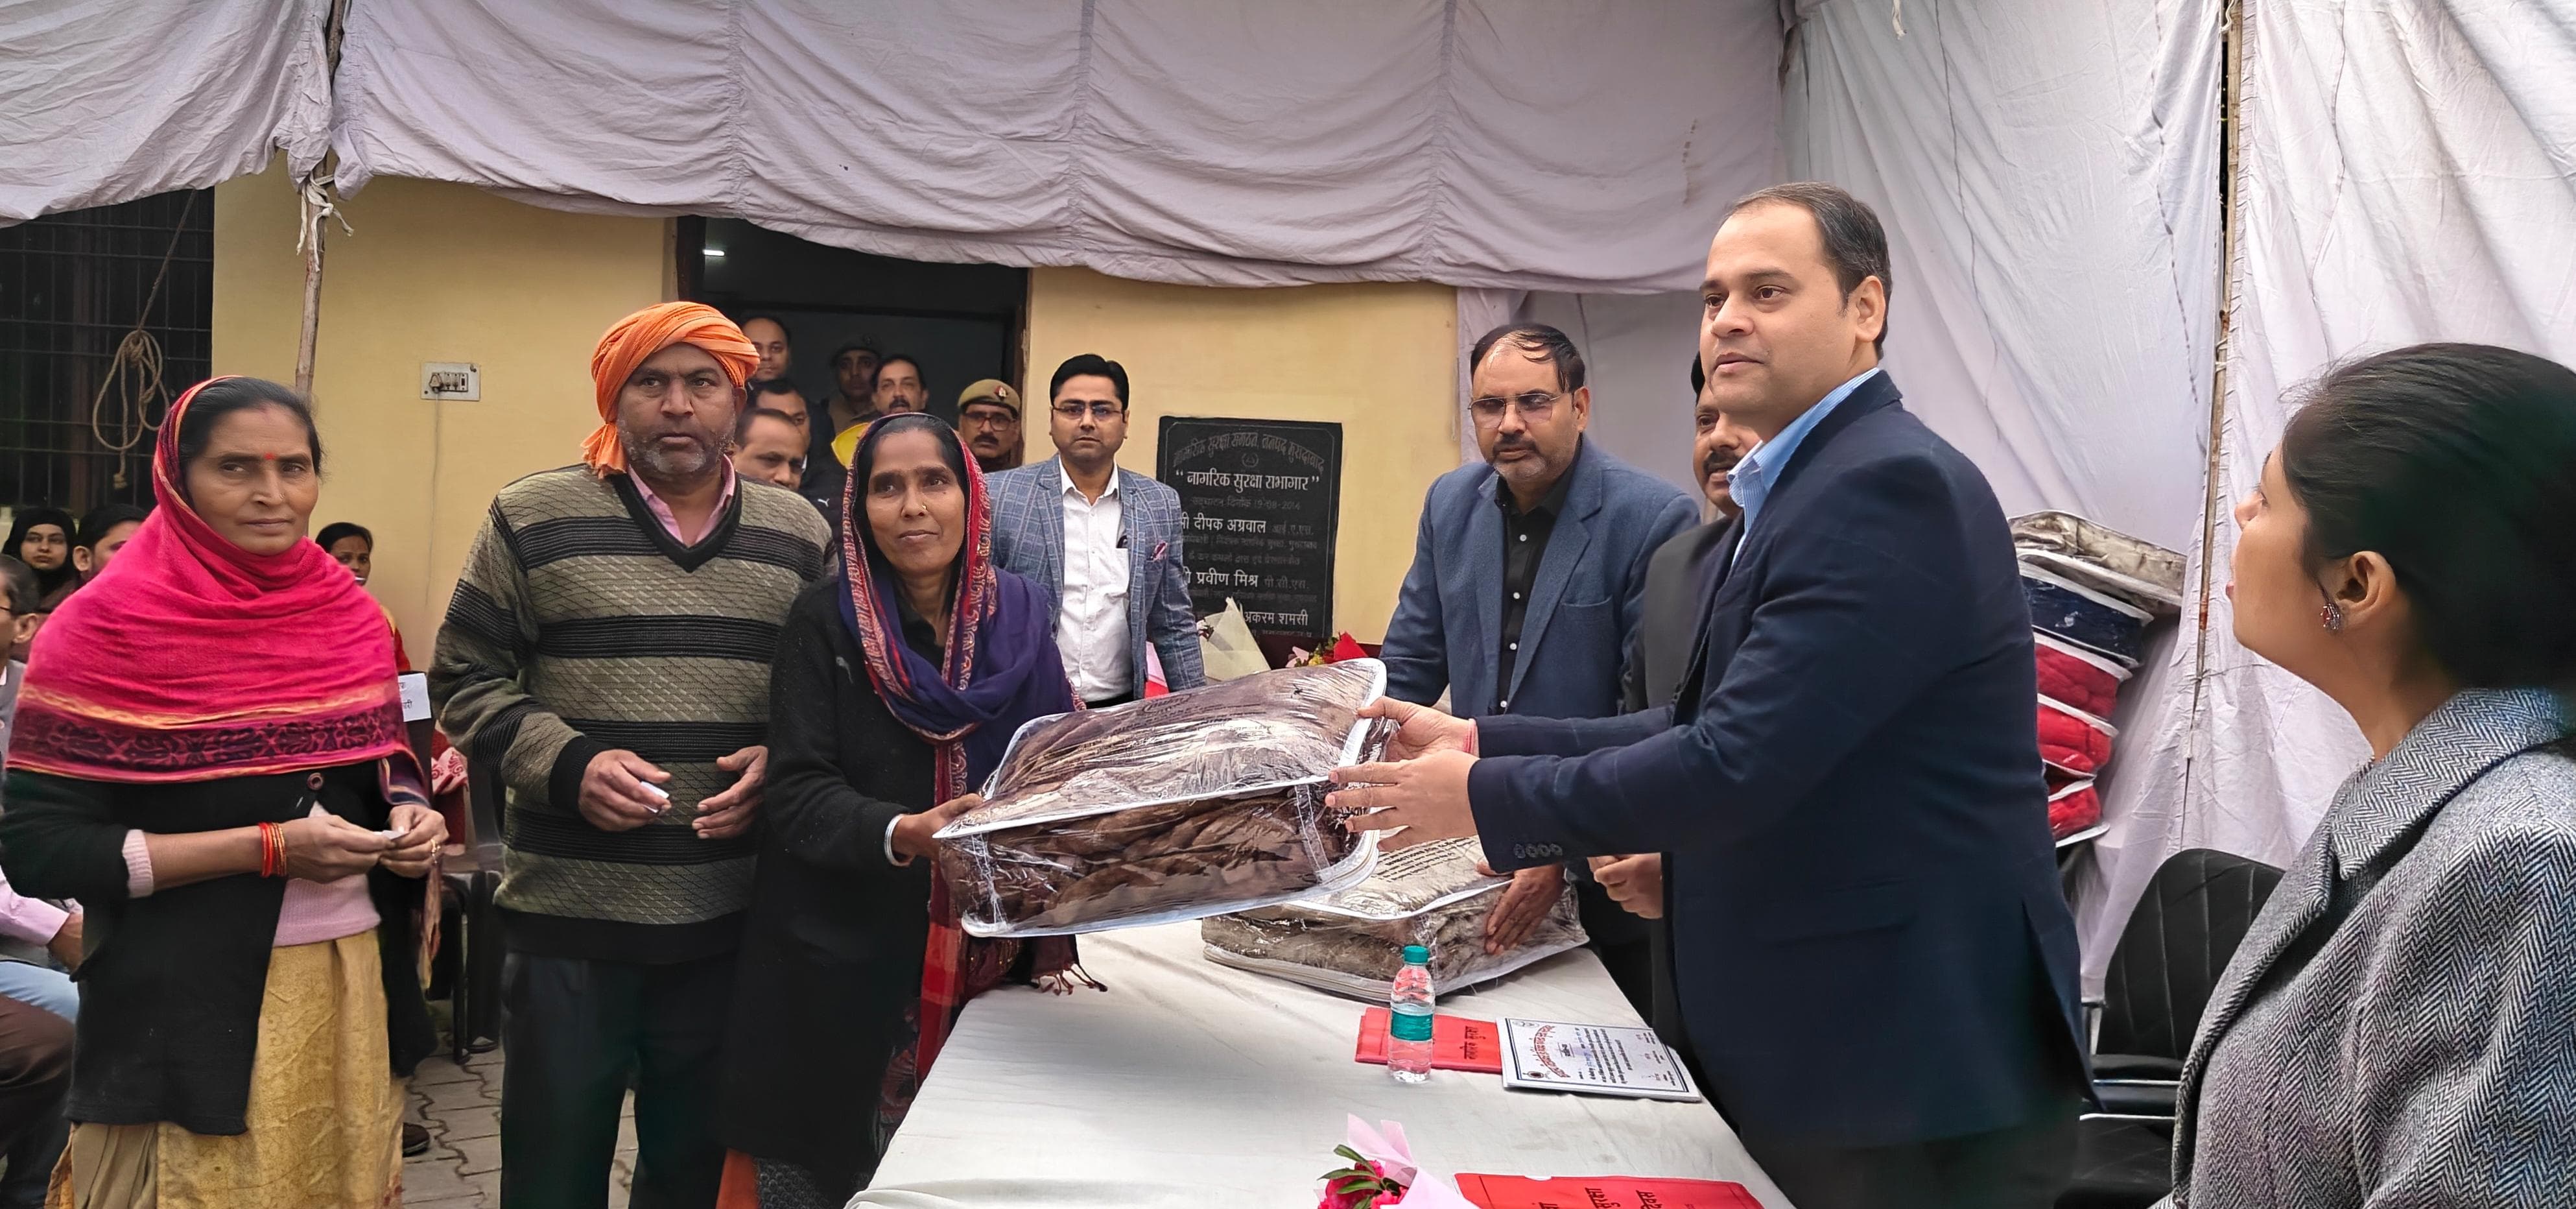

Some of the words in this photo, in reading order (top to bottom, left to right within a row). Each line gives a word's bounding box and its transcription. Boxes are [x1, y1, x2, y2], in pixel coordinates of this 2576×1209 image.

[1233, 473, 1262, 494] सुरक्षा
[1193, 512, 1224, 531] दीपक
[1227, 519, 1266, 534] अग्रवाल
[1196, 567, 1229, 586] प्रवीण
[1233, 569, 1259, 588] मिश्र
[1244, 610, 1275, 625] अकरम
[1278, 608, 1310, 627] शमसी
[1585, 1187, 1621, 1209] सुरक्षा
